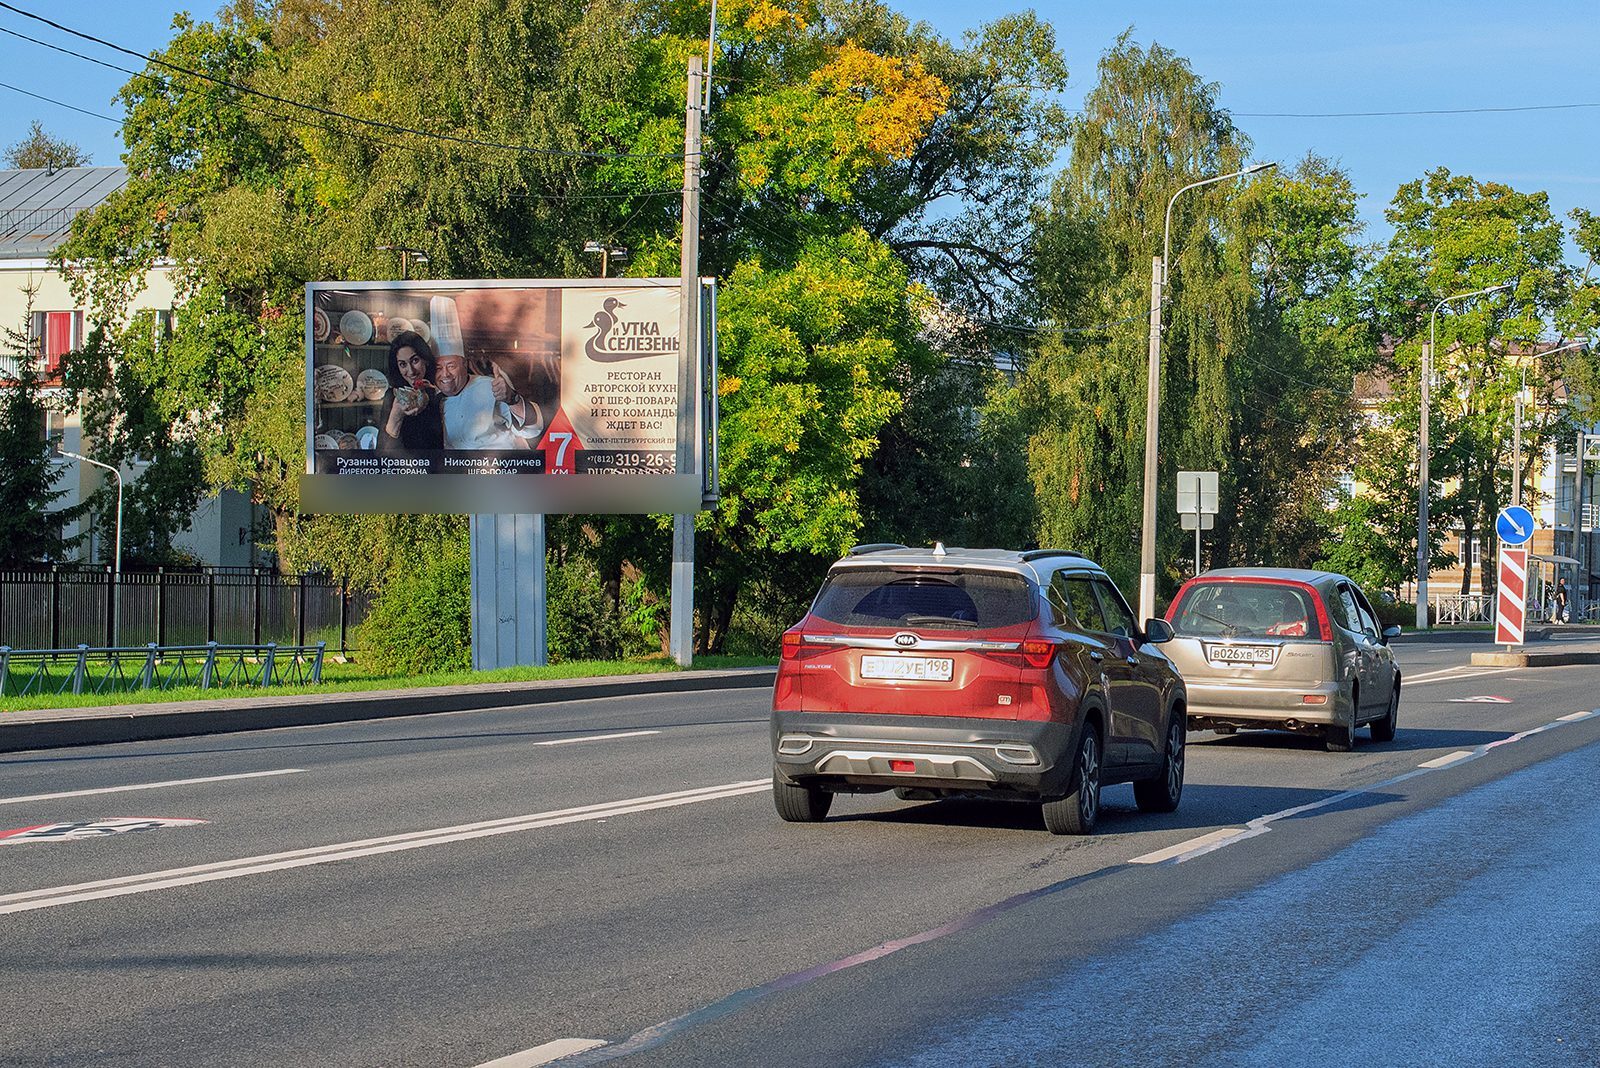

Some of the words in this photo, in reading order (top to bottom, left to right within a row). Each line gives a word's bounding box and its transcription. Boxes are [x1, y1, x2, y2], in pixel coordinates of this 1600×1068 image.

[621, 321, 660, 336] УТКА
[608, 336, 680, 351] СЕЛЕЗЕНЬ
[607, 371, 662, 381] РЕСТОРАН
[584, 382, 646, 393] АВТОРСКОЙ
[648, 383, 677, 393] КУХН
[591, 396, 605, 405] ОТ
[607, 396, 678, 405] ШЕФ-ПОВАРА
[591, 408, 598, 417] И
[601, 408, 621, 417] ЕГО
[606, 420, 637, 431] ЖДЕТ
[640, 420, 662, 430] ВАС!
[587, 437, 666, 445] САНКТ-ПЕТЕРБУРГСКИЙ
[549, 432, 573, 467] 7
[336, 457, 378, 468] Рузанна
[380, 457, 430, 468] Кравцова
[444, 457, 489, 467] Николай
[491, 457, 542, 468] Акуличев
[615, 453, 676, 466] 319-26-9
[898, 636, 914, 645] KIA
[1254, 649, 1270, 658] 125
[927, 660, 949, 672] 198
